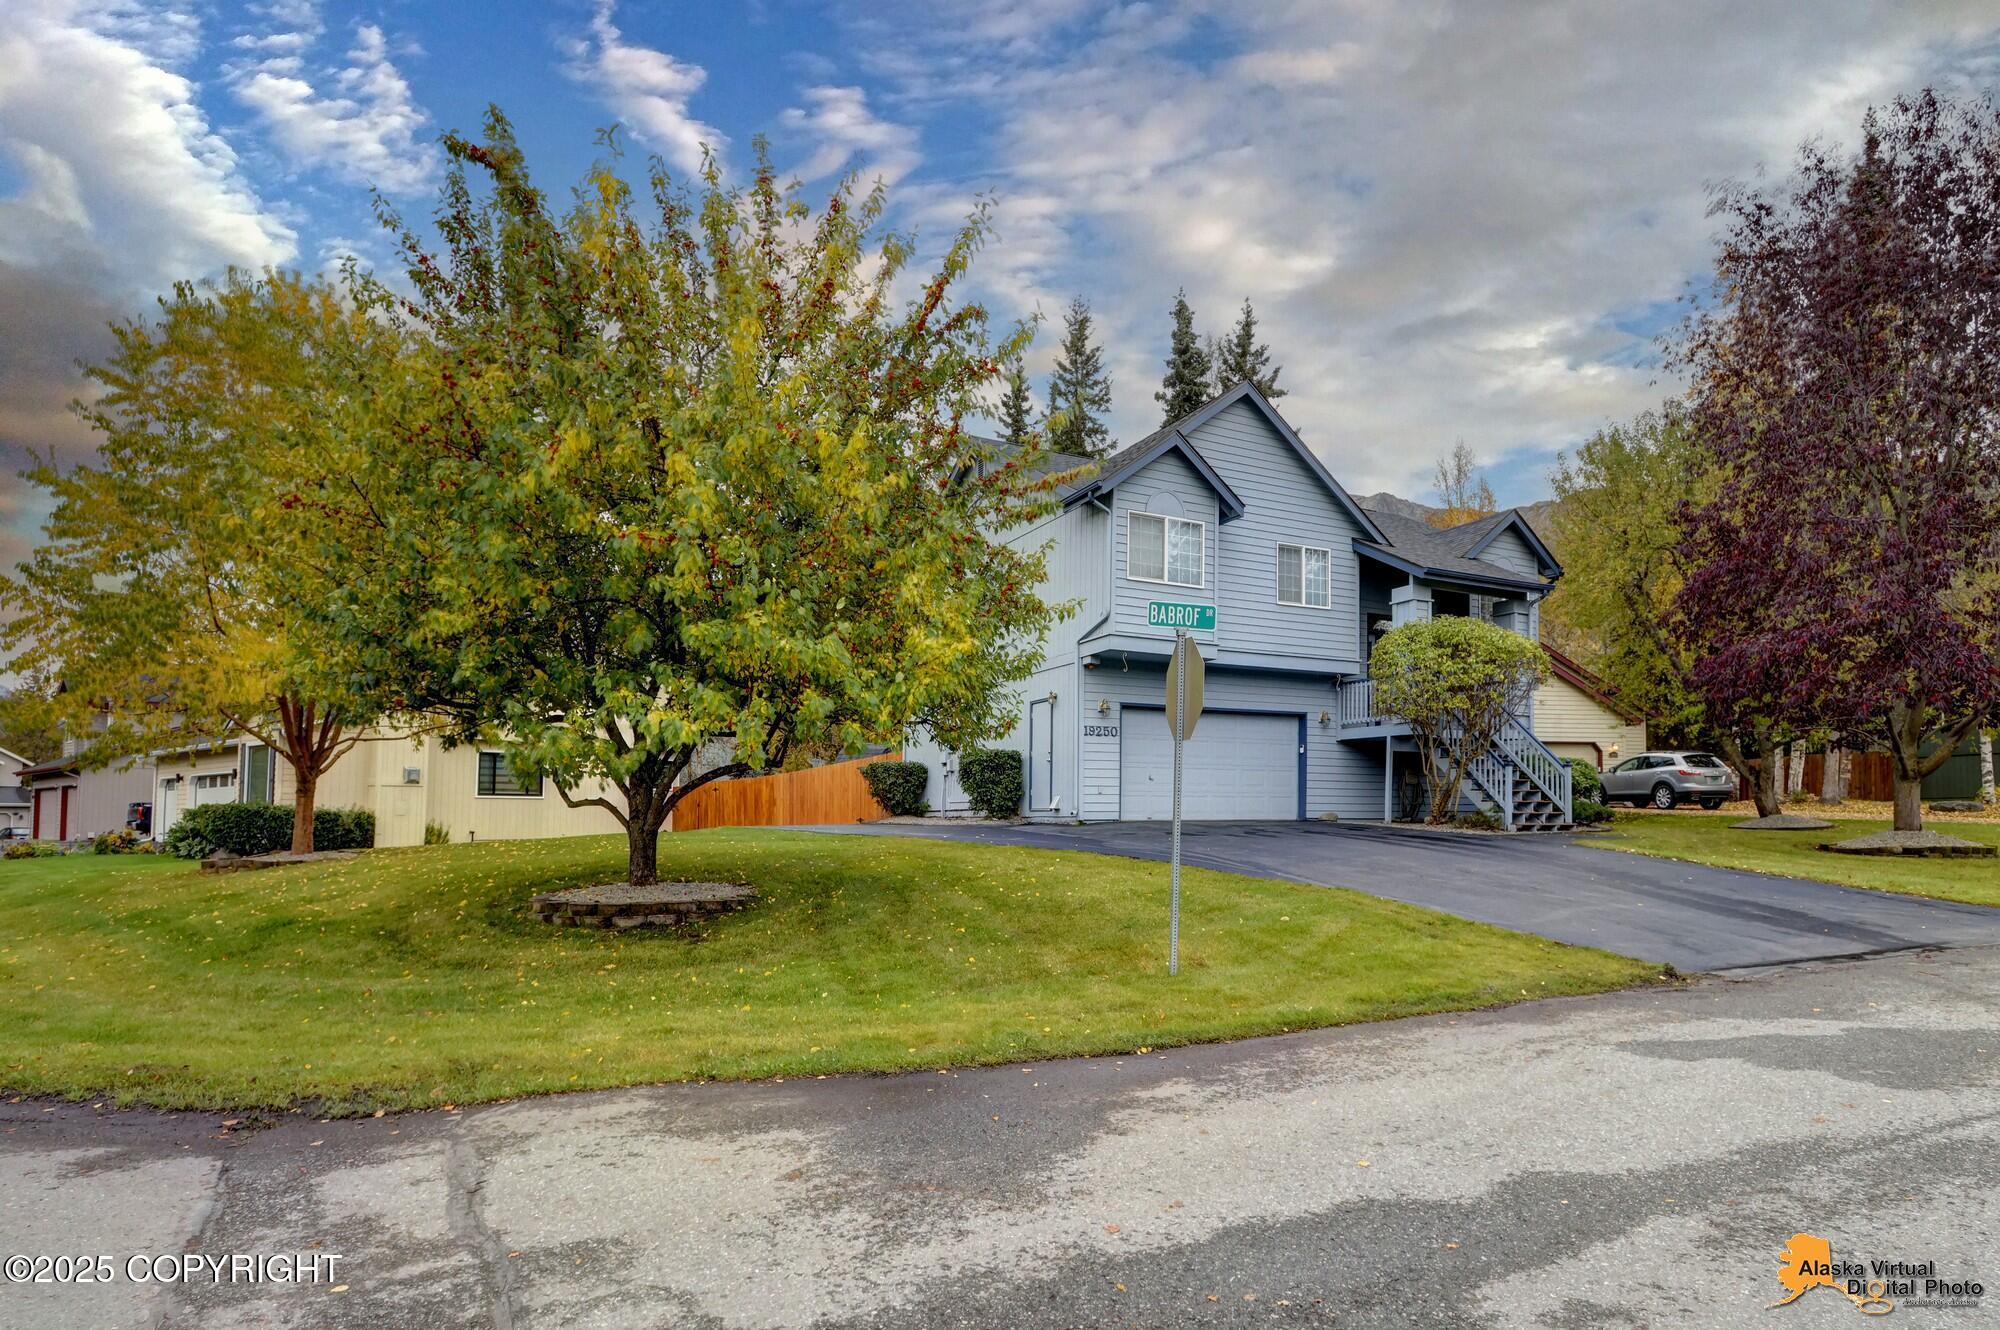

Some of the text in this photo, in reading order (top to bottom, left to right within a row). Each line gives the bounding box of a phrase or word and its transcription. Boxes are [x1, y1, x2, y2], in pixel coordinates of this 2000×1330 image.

[1150, 604, 1214, 626] BABROF DR
[1083, 725, 1118, 738] 19250
